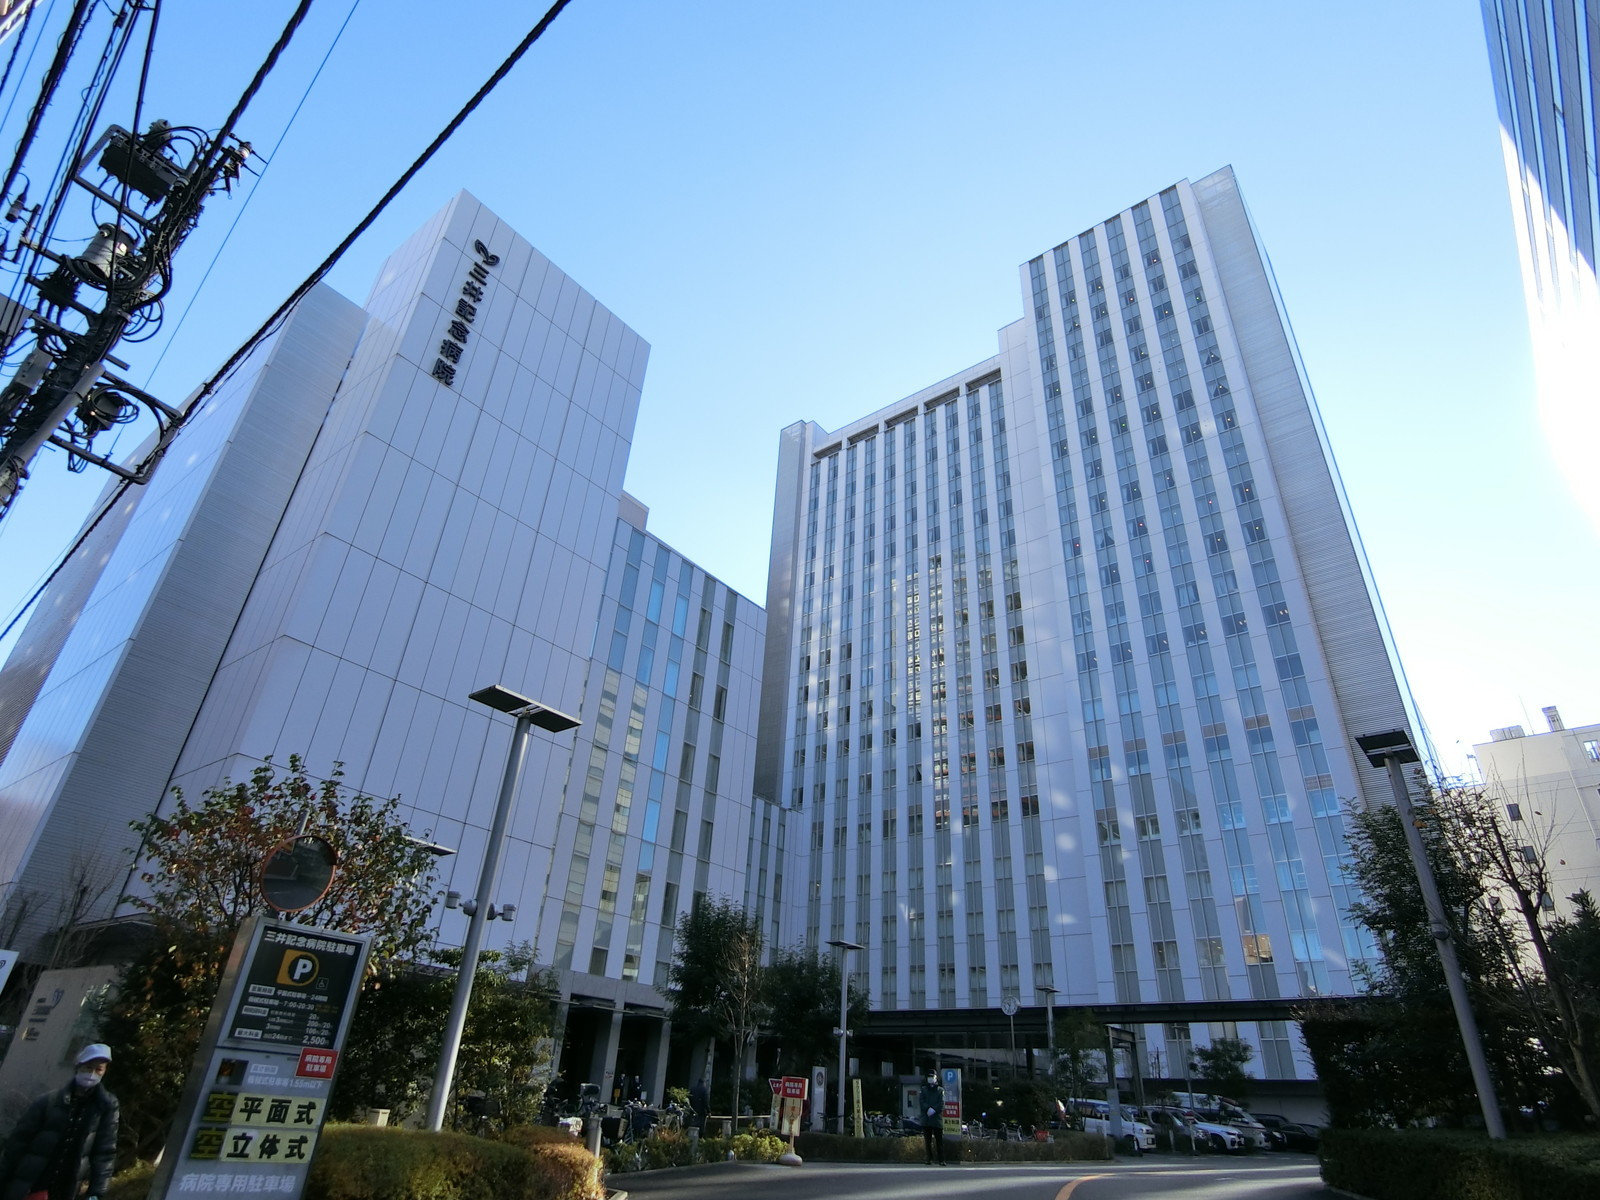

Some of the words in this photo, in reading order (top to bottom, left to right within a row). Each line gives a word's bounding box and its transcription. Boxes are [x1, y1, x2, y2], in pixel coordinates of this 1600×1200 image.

[432, 261, 490, 386] 三井記念病院
[264, 931, 356, 956] 三井記念病院駐車場
[293, 958, 313, 980] P
[305, 1055, 332, 1064] 病院専用
[306, 1064, 327, 1073] 駐車場
[239, 1096, 318, 1126] 平面式
[226, 1132, 310, 1160] 立体式
[179, 1172, 297, 1194] 病院専用駐車場
